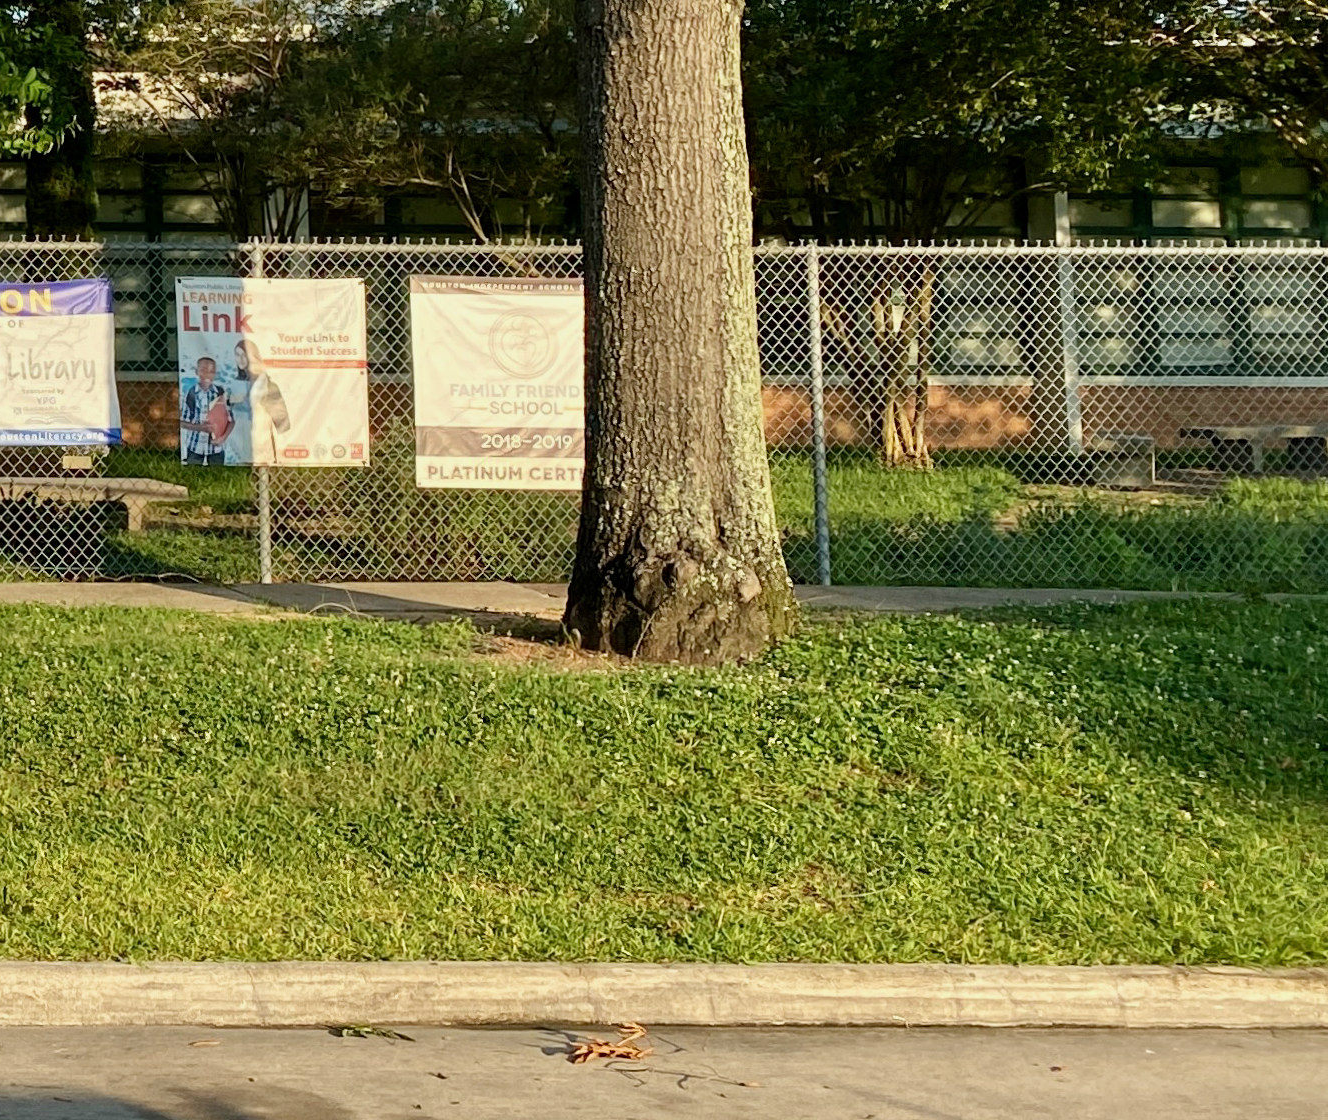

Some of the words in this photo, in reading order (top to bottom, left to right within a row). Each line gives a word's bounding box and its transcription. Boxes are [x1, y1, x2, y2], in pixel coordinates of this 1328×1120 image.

[182, 292, 253, 305] LEARNING
[7, 319, 25, 328] OF
[182, 305, 254, 333] Link
[278, 333, 304, 343] Your
[306, 332, 336, 343] eLink
[337, 334, 350, 343] to
[270, 346, 314, 356] Student
[316, 347, 358, 356] Success
[7, 347, 96, 393] Library
[450, 383, 510, 397] FAMILY
[490, 401, 564, 415] SCHOOL
[481, 434, 573, 450] 2018-2019
[428, 466, 523, 481] PLATINUM
